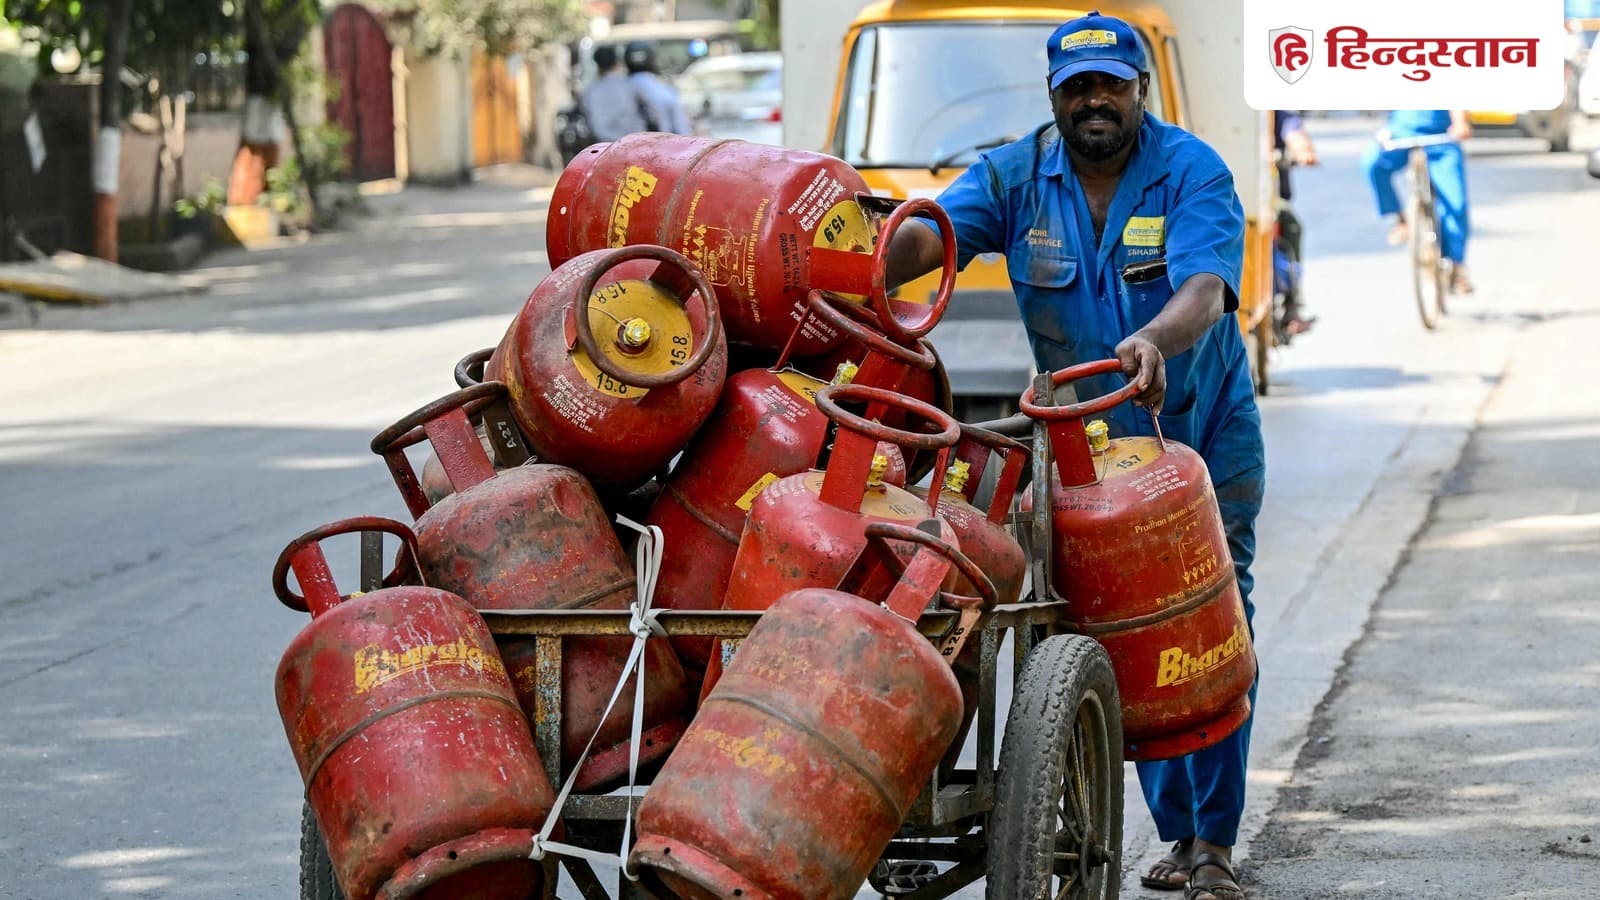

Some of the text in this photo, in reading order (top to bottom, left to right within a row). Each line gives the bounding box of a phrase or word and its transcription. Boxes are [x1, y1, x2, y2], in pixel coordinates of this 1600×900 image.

[824, 214, 846, 244] 15.9
[747, 233, 759, 263] Mantri
[593, 281, 627, 305] 15.8
[670, 335, 688, 366] 15.8
[552, 396, 587, 424] REGULATOR
[558, 408, 571, 420] NOT
[579, 423, 593, 433] USE
[577, 410, 591, 420] OFF
[1116, 455, 1142, 470] 15.7
[1134, 518, 1168, 534] Pradhan
